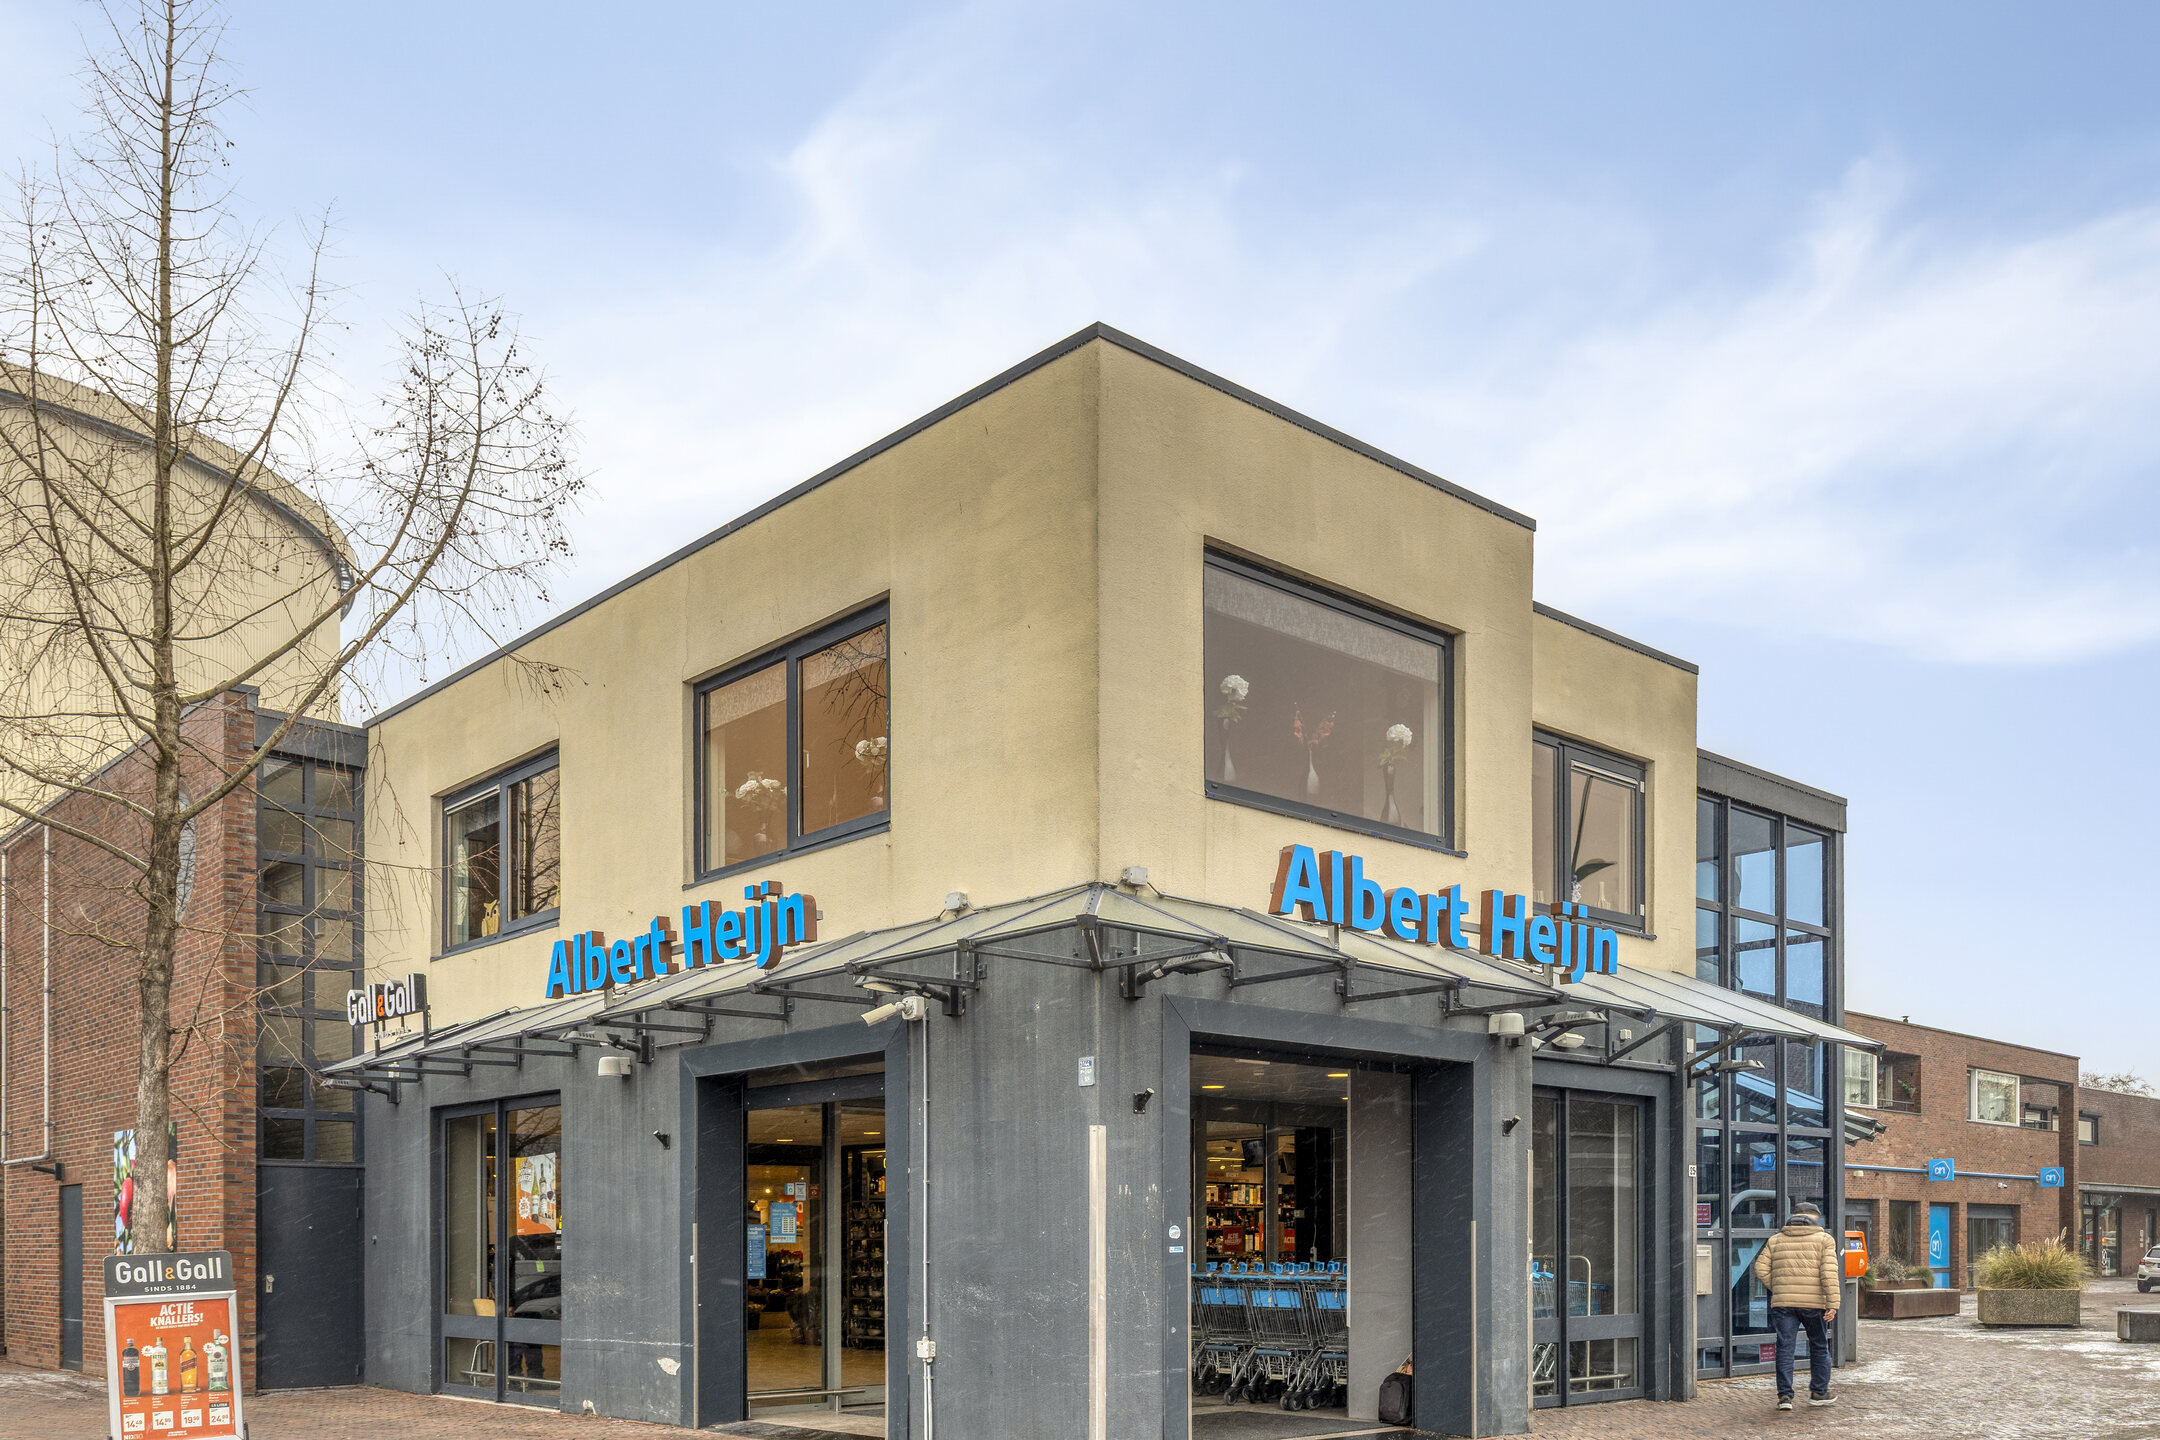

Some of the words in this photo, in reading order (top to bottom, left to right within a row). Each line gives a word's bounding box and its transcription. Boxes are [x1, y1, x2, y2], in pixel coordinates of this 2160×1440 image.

[1280, 843, 1469, 950] Albert
[1491, 889, 1618, 984] Heijn
[546, 915, 670, 999] Albert
[682, 880, 806, 970] Heijn
[347, 973, 416, 1026] Gall&Gall
[115, 1257, 222, 1284] Gall&Gall
[150, 1313, 203, 1327] KNALLERS!
[160, 1302, 194, 1316] ACTIE
